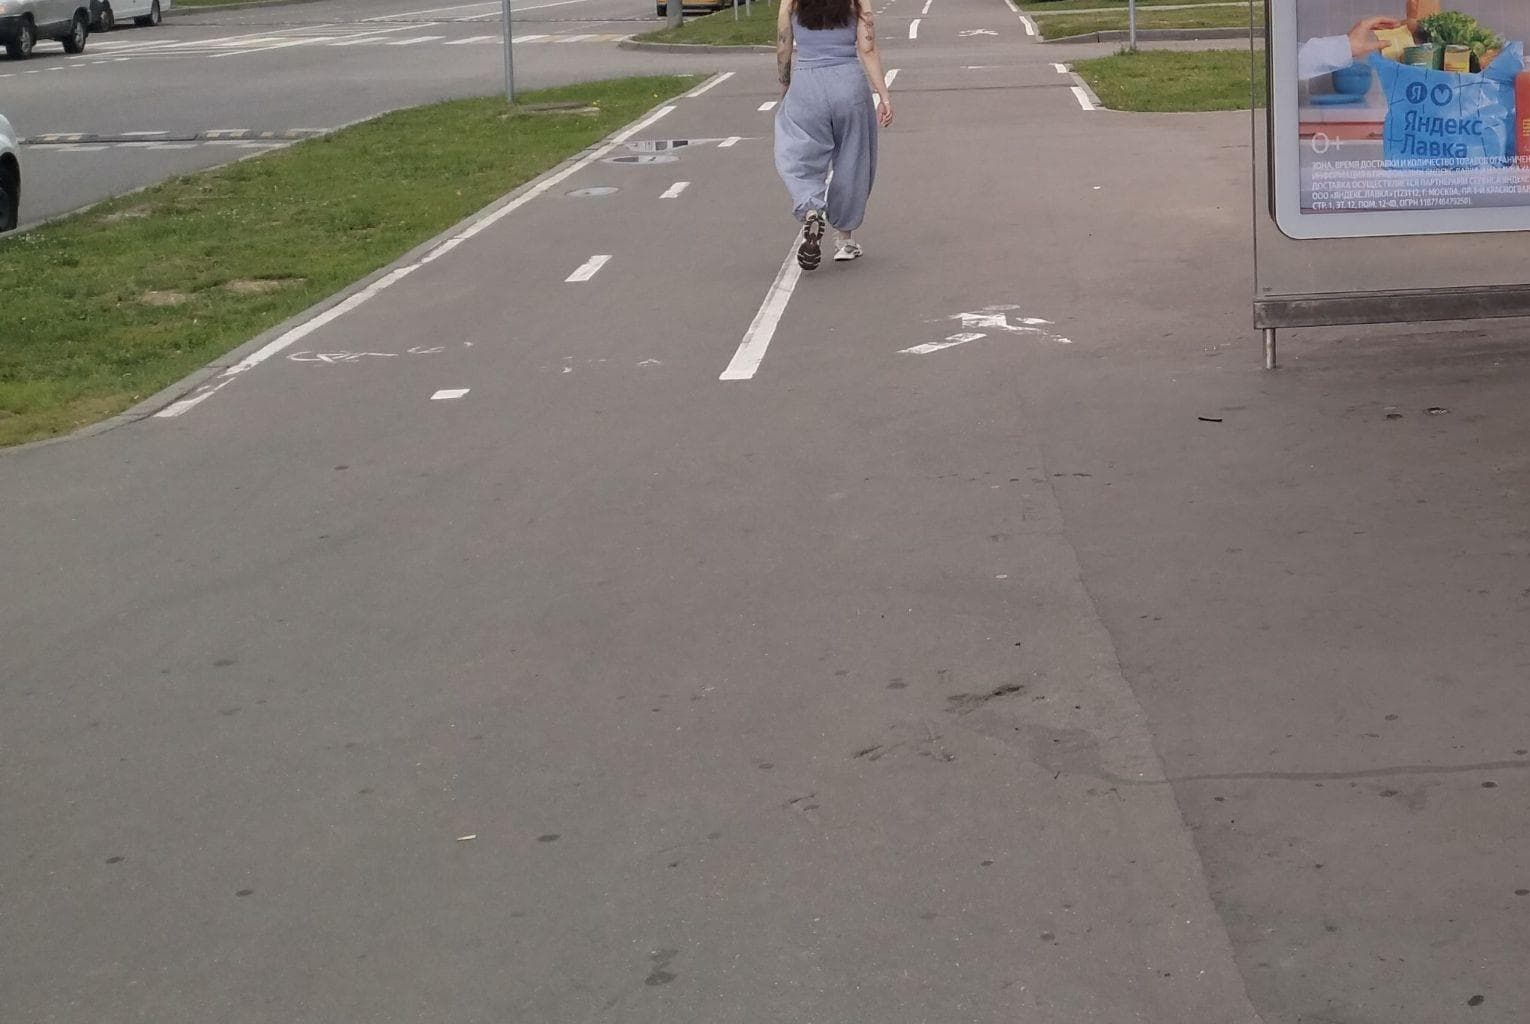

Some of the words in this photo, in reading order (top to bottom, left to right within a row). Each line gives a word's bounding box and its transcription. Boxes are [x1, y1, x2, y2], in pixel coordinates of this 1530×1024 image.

[1403, 109, 1483, 137] Яндекс
[1311, 132, 1344, 154] 0+
[1400, 134, 1469, 158] Лавка
